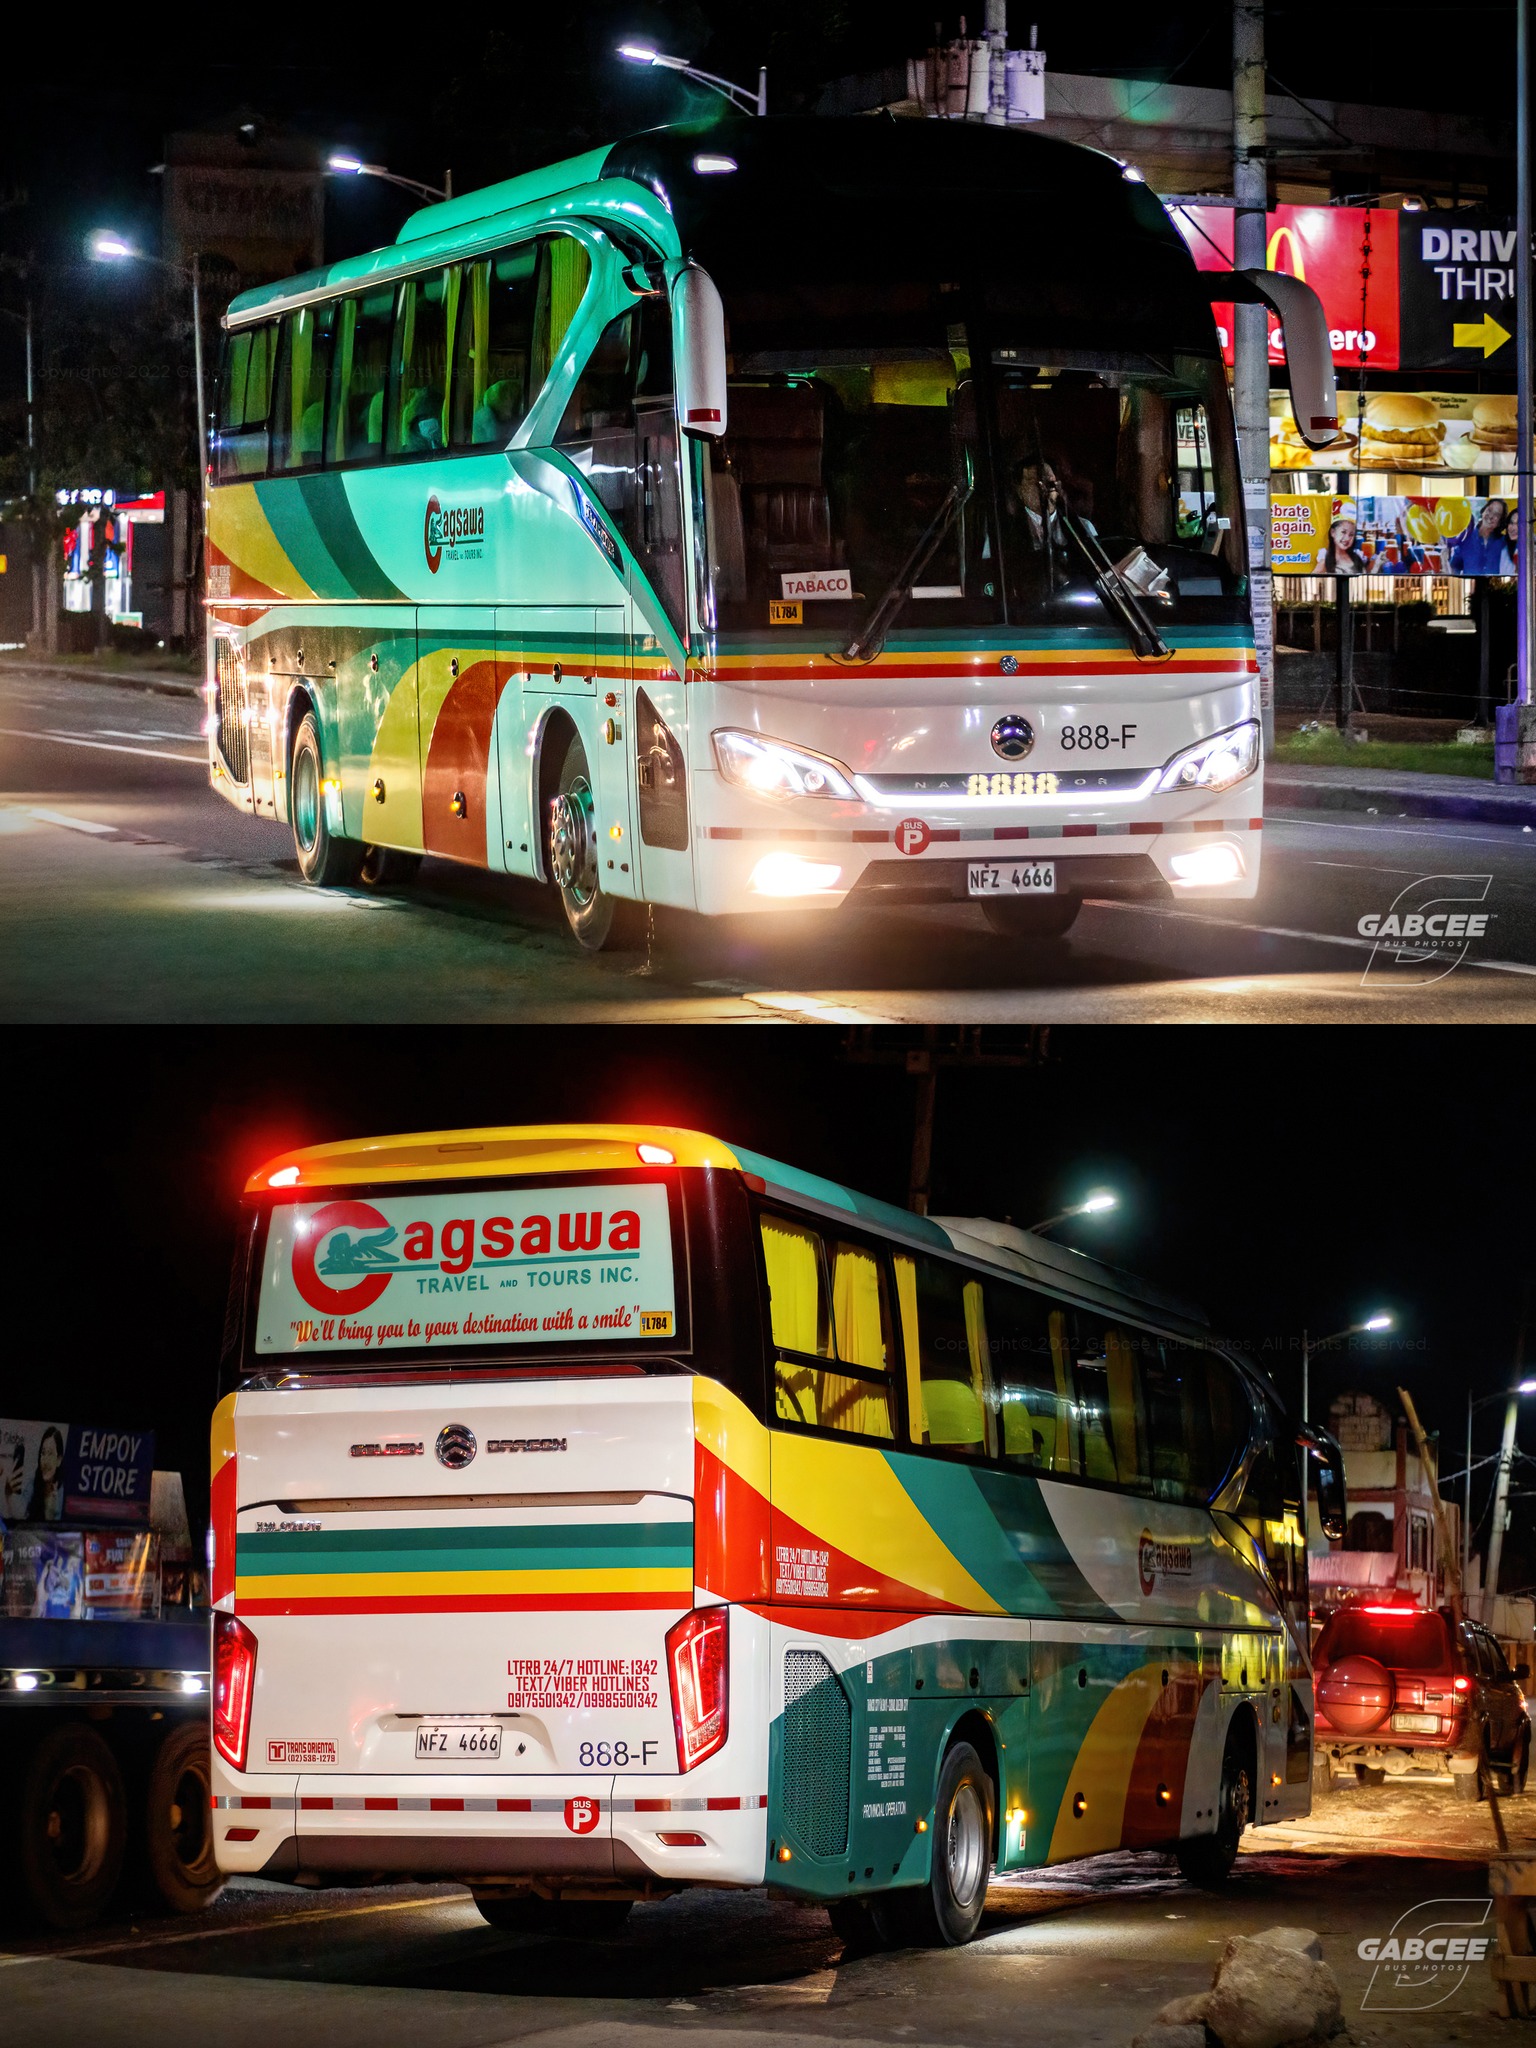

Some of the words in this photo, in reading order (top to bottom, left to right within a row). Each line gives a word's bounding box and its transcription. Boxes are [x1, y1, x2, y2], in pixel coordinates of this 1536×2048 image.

[1274, 520, 1316, 535] again,
[785, 578, 848, 594] TABACO
[1061, 725, 1137, 750] 888-F
[903, 822, 923, 830] BUS
[904, 831, 923, 854] P
[970, 870, 1000, 888] NFZ
[1011, 868, 1053, 887] 4666
[417, 1275, 489, 1294] TRAVEL
[500, 1279, 518, 1288] AND
[527, 1268, 591, 1287] TOURS
[600, 1266, 639, 1284] INC.
[338, 1319, 374, 1346] bring
[378, 1325, 404, 1345] you
[407, 1318, 421, 1337] to
[424, 1321, 459, 1343] your
[463, 1312, 539, 1335] destination
[542, 1308, 575, 1331] with
[578, 1315, 588, 1329] a
[592, 1305, 640, 1329] smile"
[79, 1431, 141, 1463] EMPOY
[78, 1465, 138, 1497] STORE
[507, 1660, 540, 1675] LTFRB
[544, 1659, 573, 1676] 24/7
[577, 1660, 658, 1675] HOTLINE:1342
[516, 1676, 587, 1692] TEXT/VIBER
[592, 1676, 650, 1692] HOTLINES
[507, 1692, 658, 1709] 09175501342/09985501342
[287, 1742, 307, 1754] TRANS
[308, 1742, 336, 1754] ORIENTAL
[419, 1733, 448, 1751] NFZ
[459, 1733, 498, 1751] 4666
[579, 1741, 659, 1767] 888-F
[572, 1800, 592, 1808] BUS
[573, 1809, 592, 1830] P
